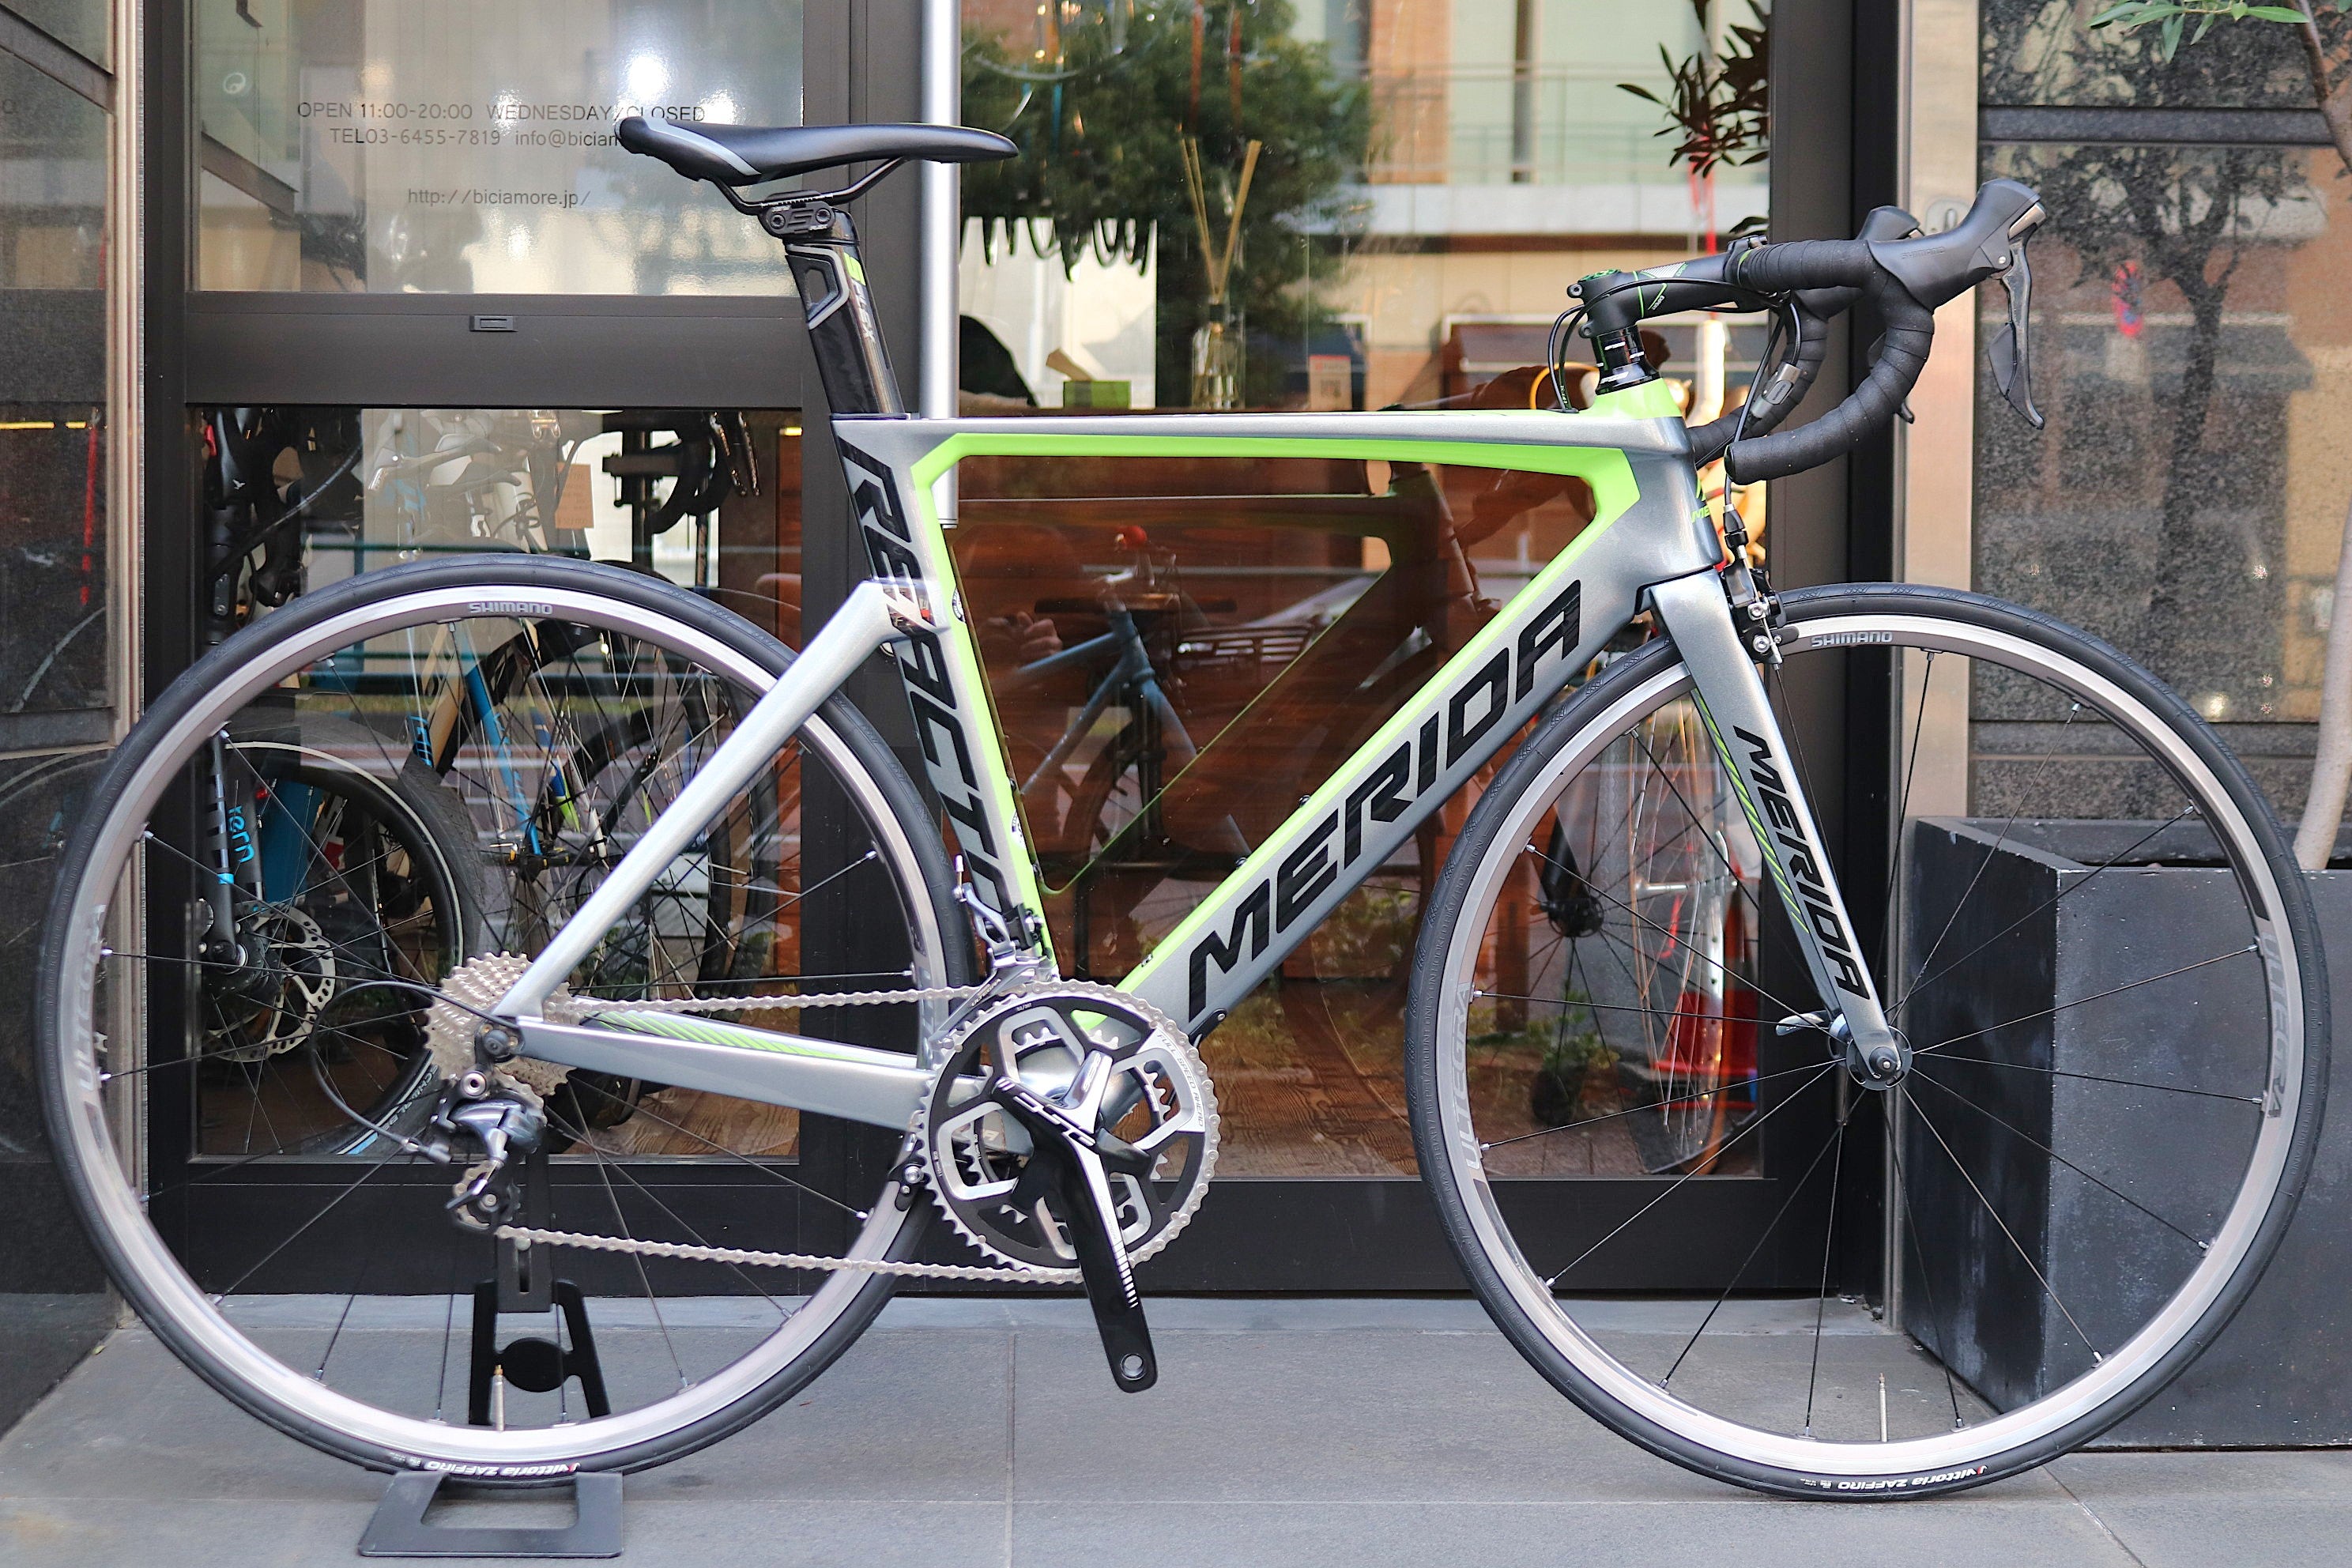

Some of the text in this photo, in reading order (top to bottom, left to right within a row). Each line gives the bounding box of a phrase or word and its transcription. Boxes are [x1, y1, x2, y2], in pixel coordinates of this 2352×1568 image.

[296, 102, 352, 118] OPEN
[361, 104, 473, 120] 11:00-20:00
[408, 188, 591, 207] http://biciamore.jp/
[468, 601, 553, 616] SHIMANO
[1811, 630, 1894, 647] SHIMANO
[1189, 579, 1581, 1023] MERIDA
[1732, 725, 1871, 1001] MERIDA
[2260, 930, 2290, 1118] ULTEGRA
[1157, 1034, 1204, 1127] FULL SPEED AHEAD
[1453, 982, 1483, 1171] ULTEGRA
[425, 1461, 500, 1476] ZAFFIRO
[1837, 1478, 1909, 1490] ZAFFIRO
